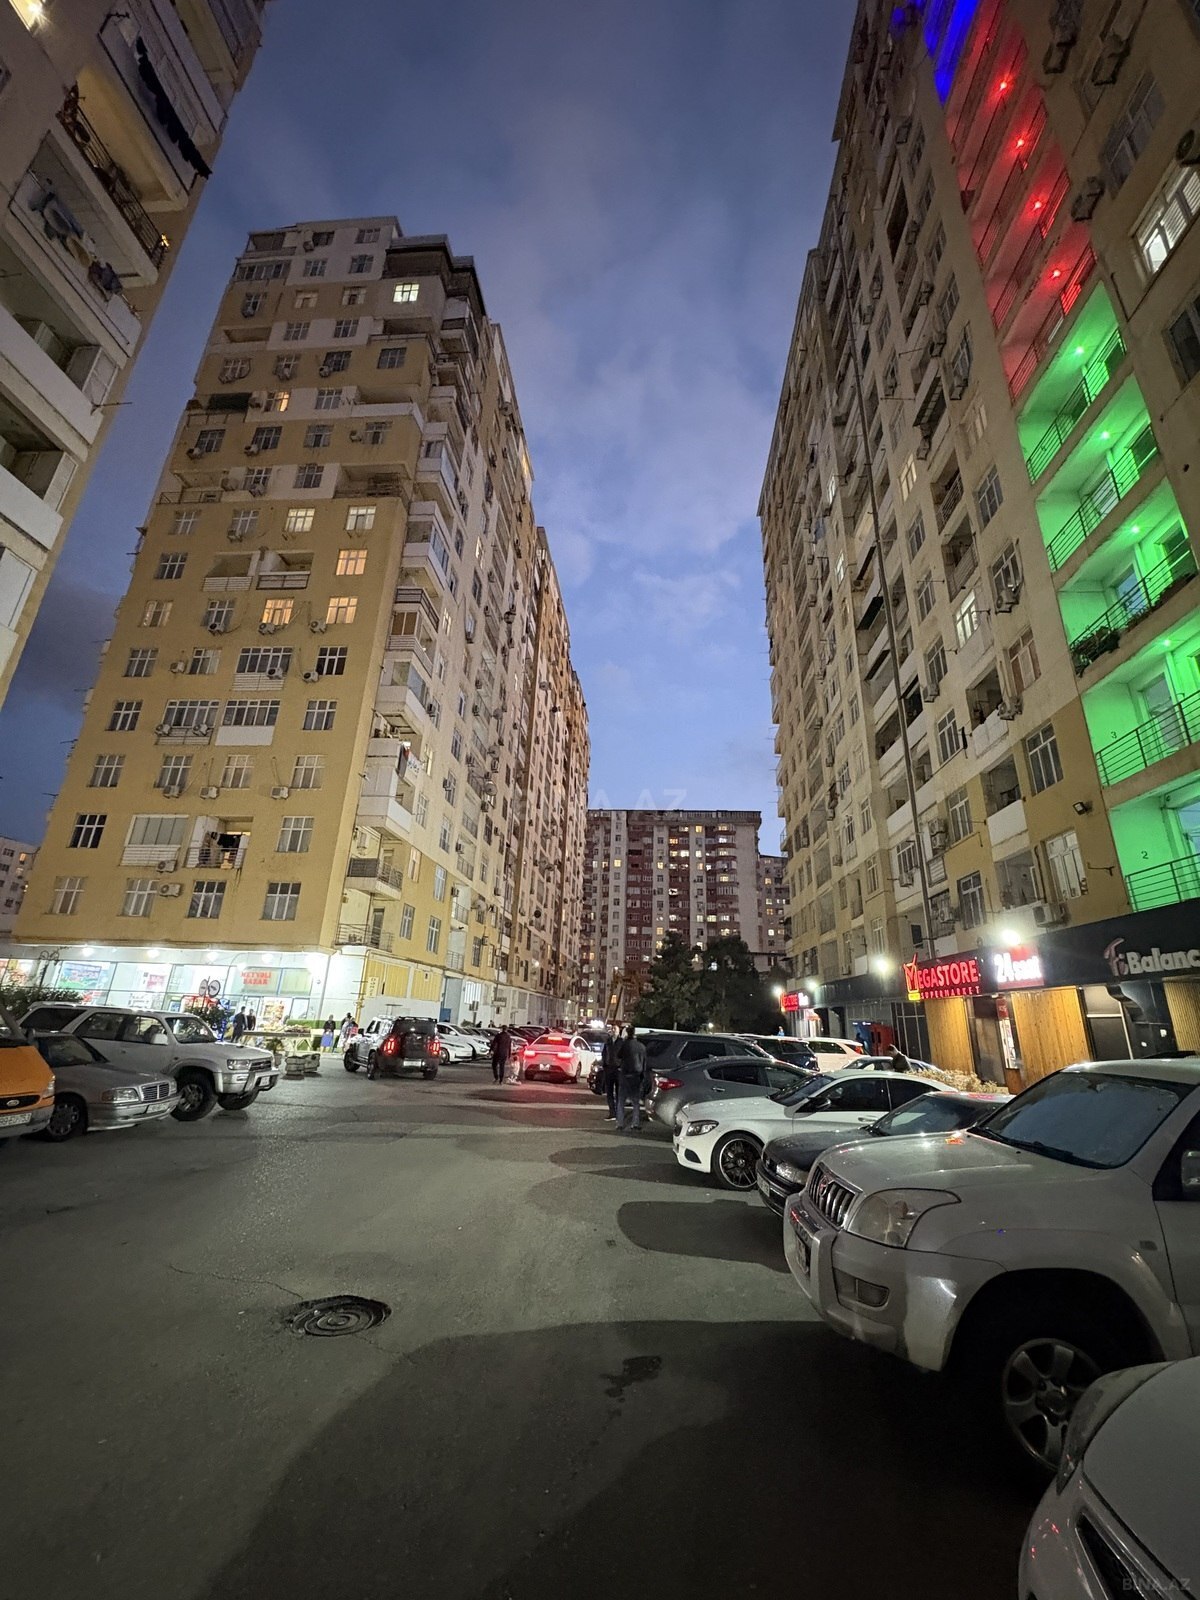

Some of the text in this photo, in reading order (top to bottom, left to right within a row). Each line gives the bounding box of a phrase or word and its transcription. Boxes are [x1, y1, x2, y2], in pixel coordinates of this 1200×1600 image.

[1110, 731, 1118, 740] 3
[1141, 850, 1149, 860] 2
[903, 953, 979, 993] MEGASTORE
[920, 985, 980, 1000] SUPERMARKET
